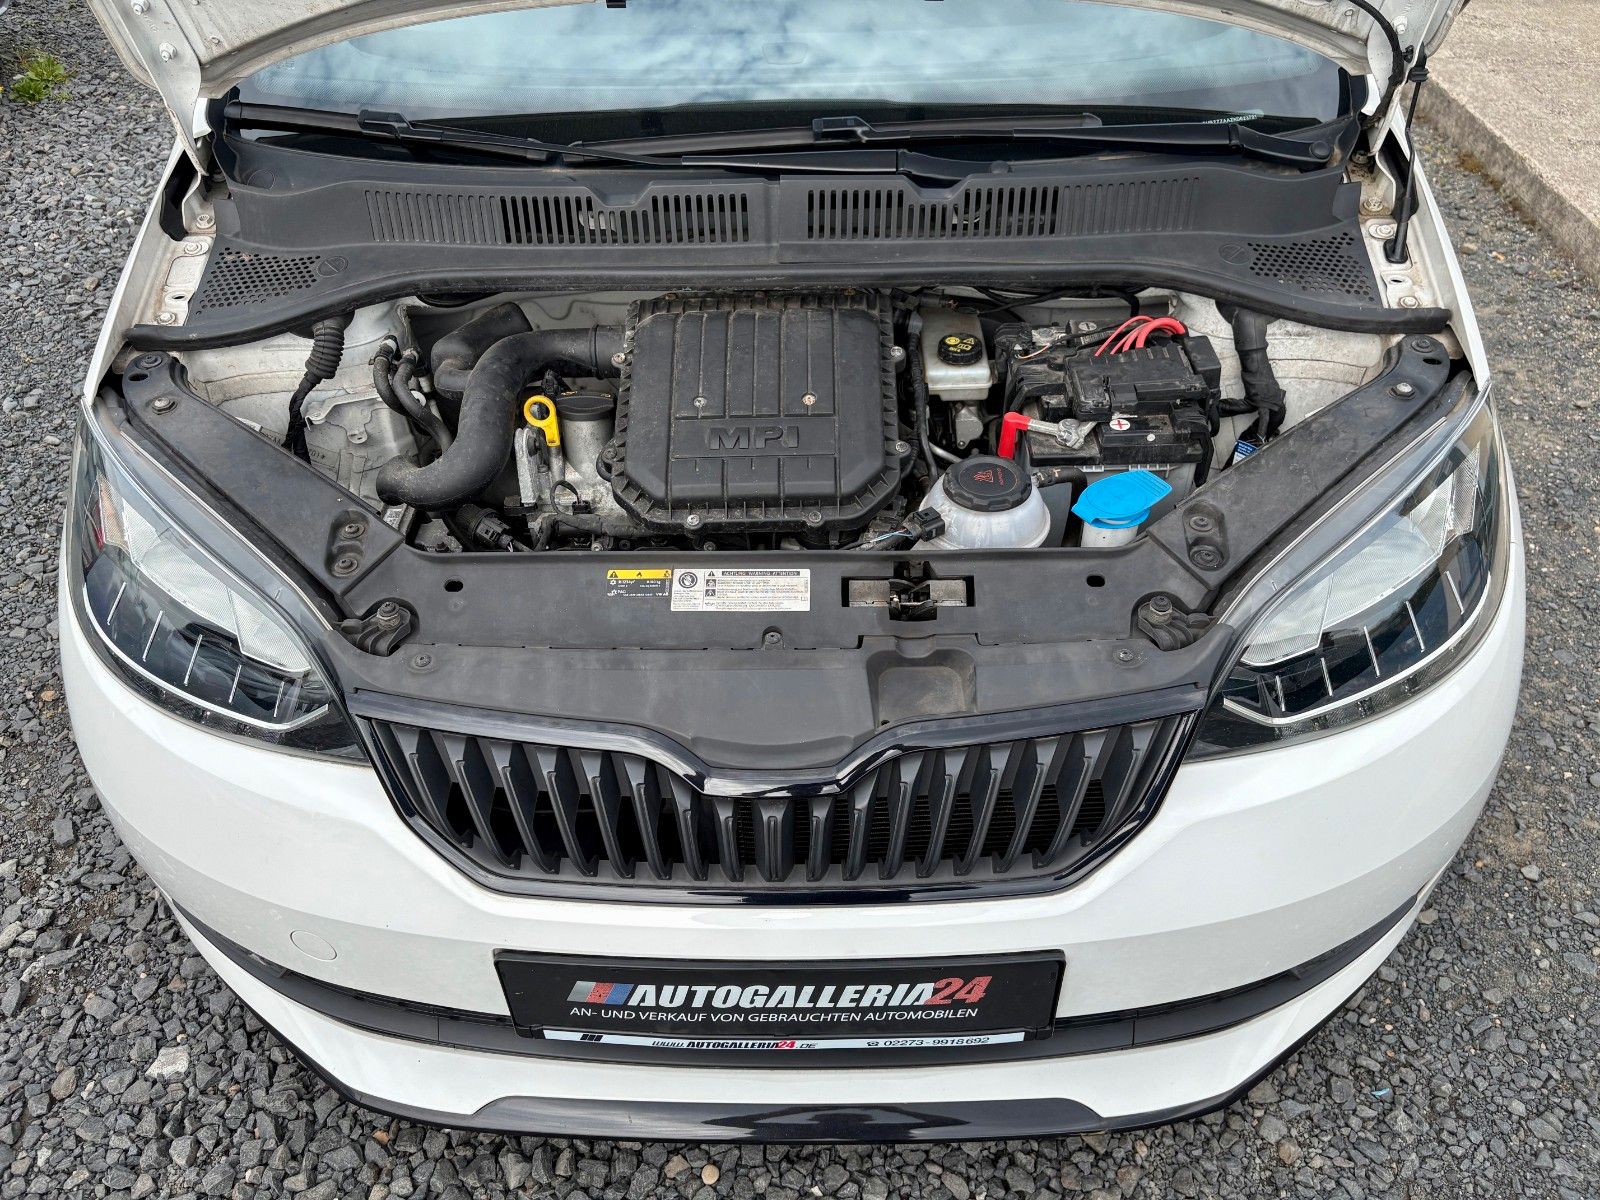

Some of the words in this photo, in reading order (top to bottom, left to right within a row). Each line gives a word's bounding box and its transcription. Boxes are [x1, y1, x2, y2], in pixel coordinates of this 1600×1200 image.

[709, 425, 800, 450] MPI
[626, 975, 993, 1009] AUTOGALLERIA24
[570, 1007, 598, 1017] AN-
[601, 1009, 636, 1020] UND
[640, 1011, 708, 1022] VERKAUF
[710, 1013, 744, 1022] VON
[748, 1012, 862, 1023] GEBRAUCHTEN
[863, 1007, 979, 1022] AUTOMOBILEN
